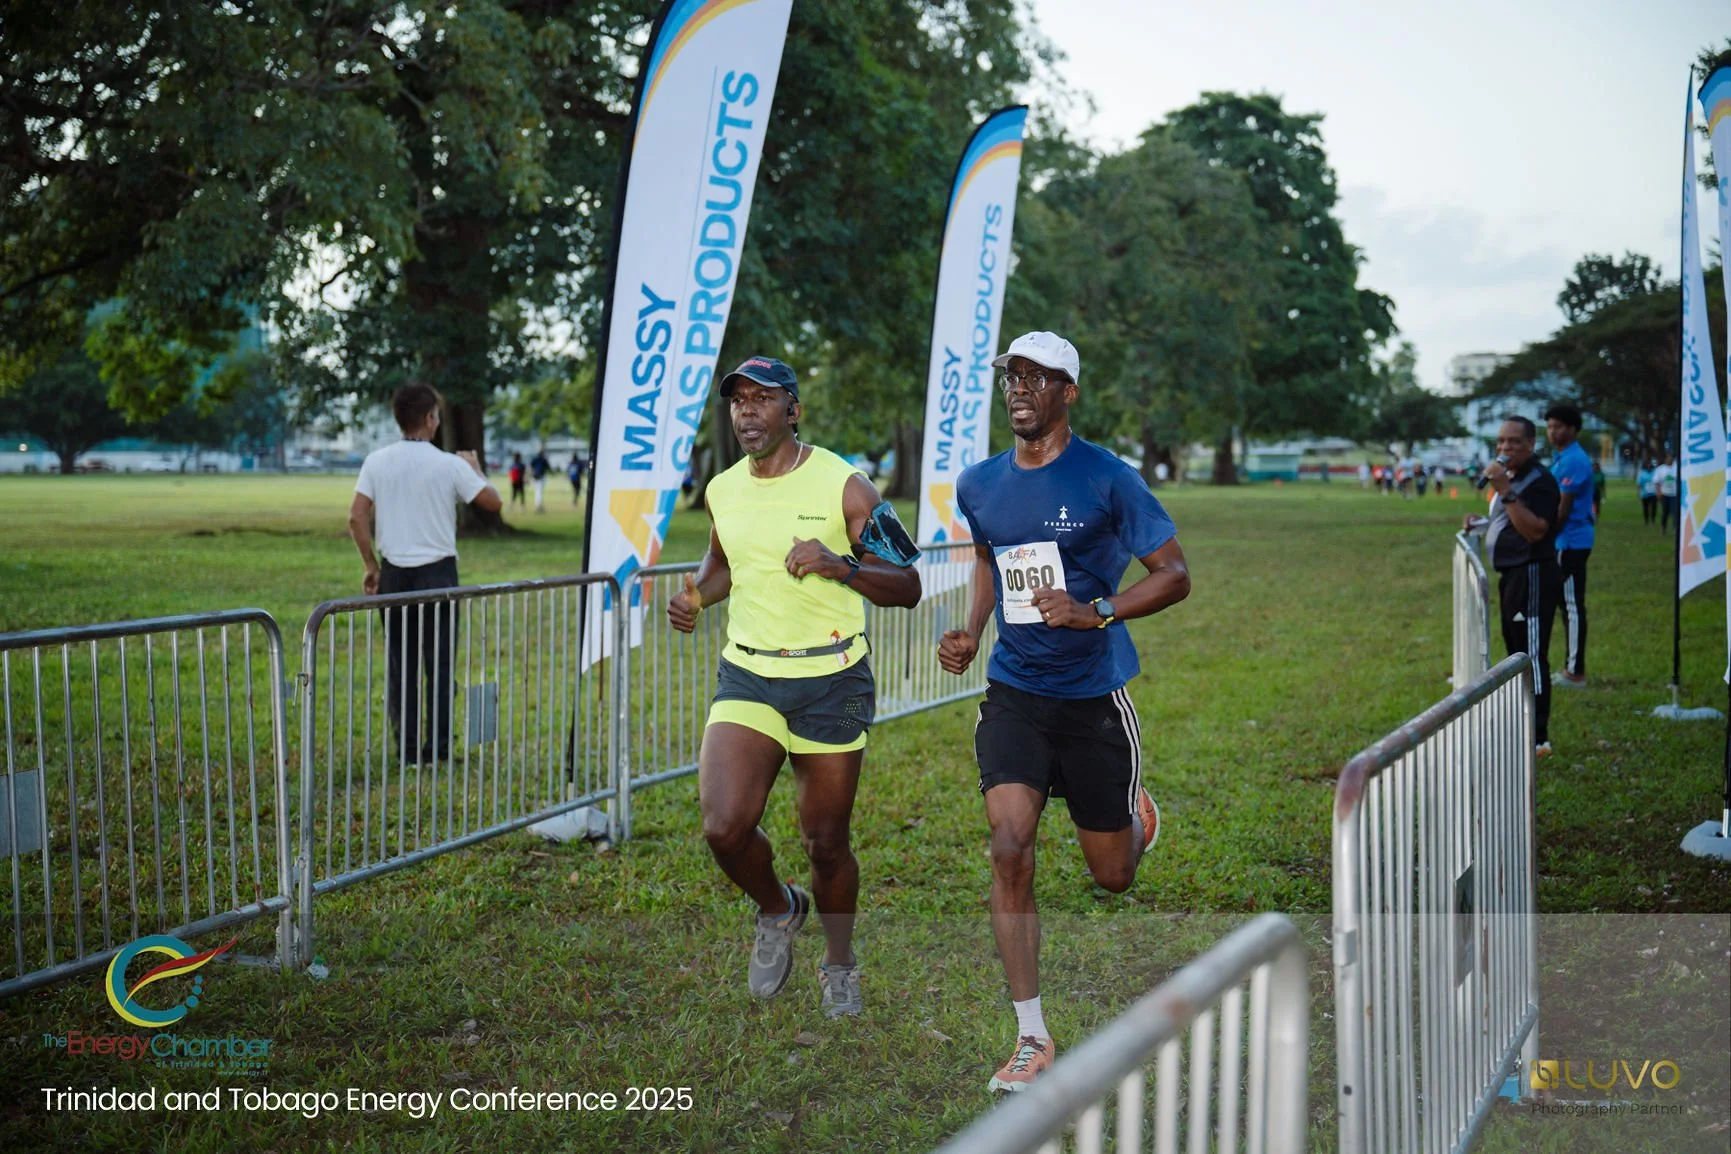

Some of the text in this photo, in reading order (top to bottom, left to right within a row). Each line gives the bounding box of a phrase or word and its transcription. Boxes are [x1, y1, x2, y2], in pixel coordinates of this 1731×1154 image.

[683, 69, 760, 357] PRODUCTS
[964, 203, 1002, 394] PRODUCTS
[620, 282, 676, 472] MASSY
[934, 345, 962, 471] MASSY
[1006, 564, 1056, 592] 0060
